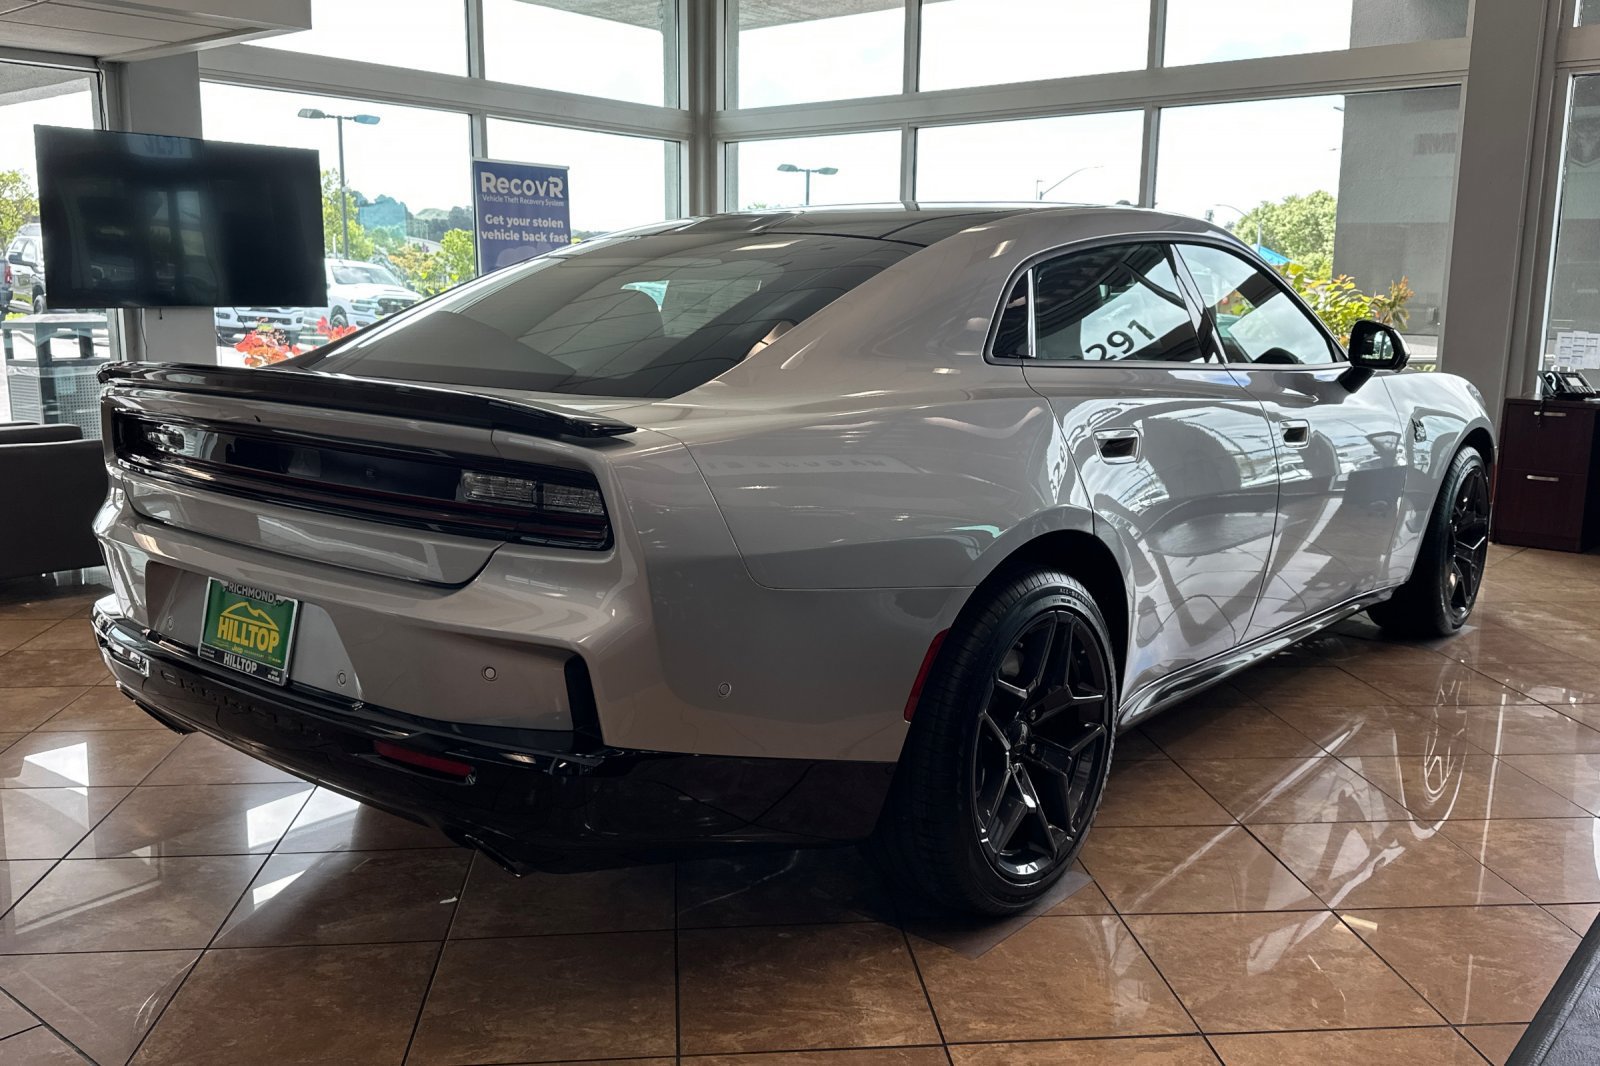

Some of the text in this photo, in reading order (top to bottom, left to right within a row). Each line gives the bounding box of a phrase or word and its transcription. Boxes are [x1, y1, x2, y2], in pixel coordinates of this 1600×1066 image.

[480, 171, 563, 198] RecovR
[482, 194, 564, 207] Vehicle Theft Recovery System
[485, 214, 564, 229] Get your stolen
[481, 229, 568, 243] vehicle back fast
[228, 582, 274, 603] RICHMOND
[217, 616, 280, 653] HILLTOP
[223, 653, 258, 673] HILLTOP
